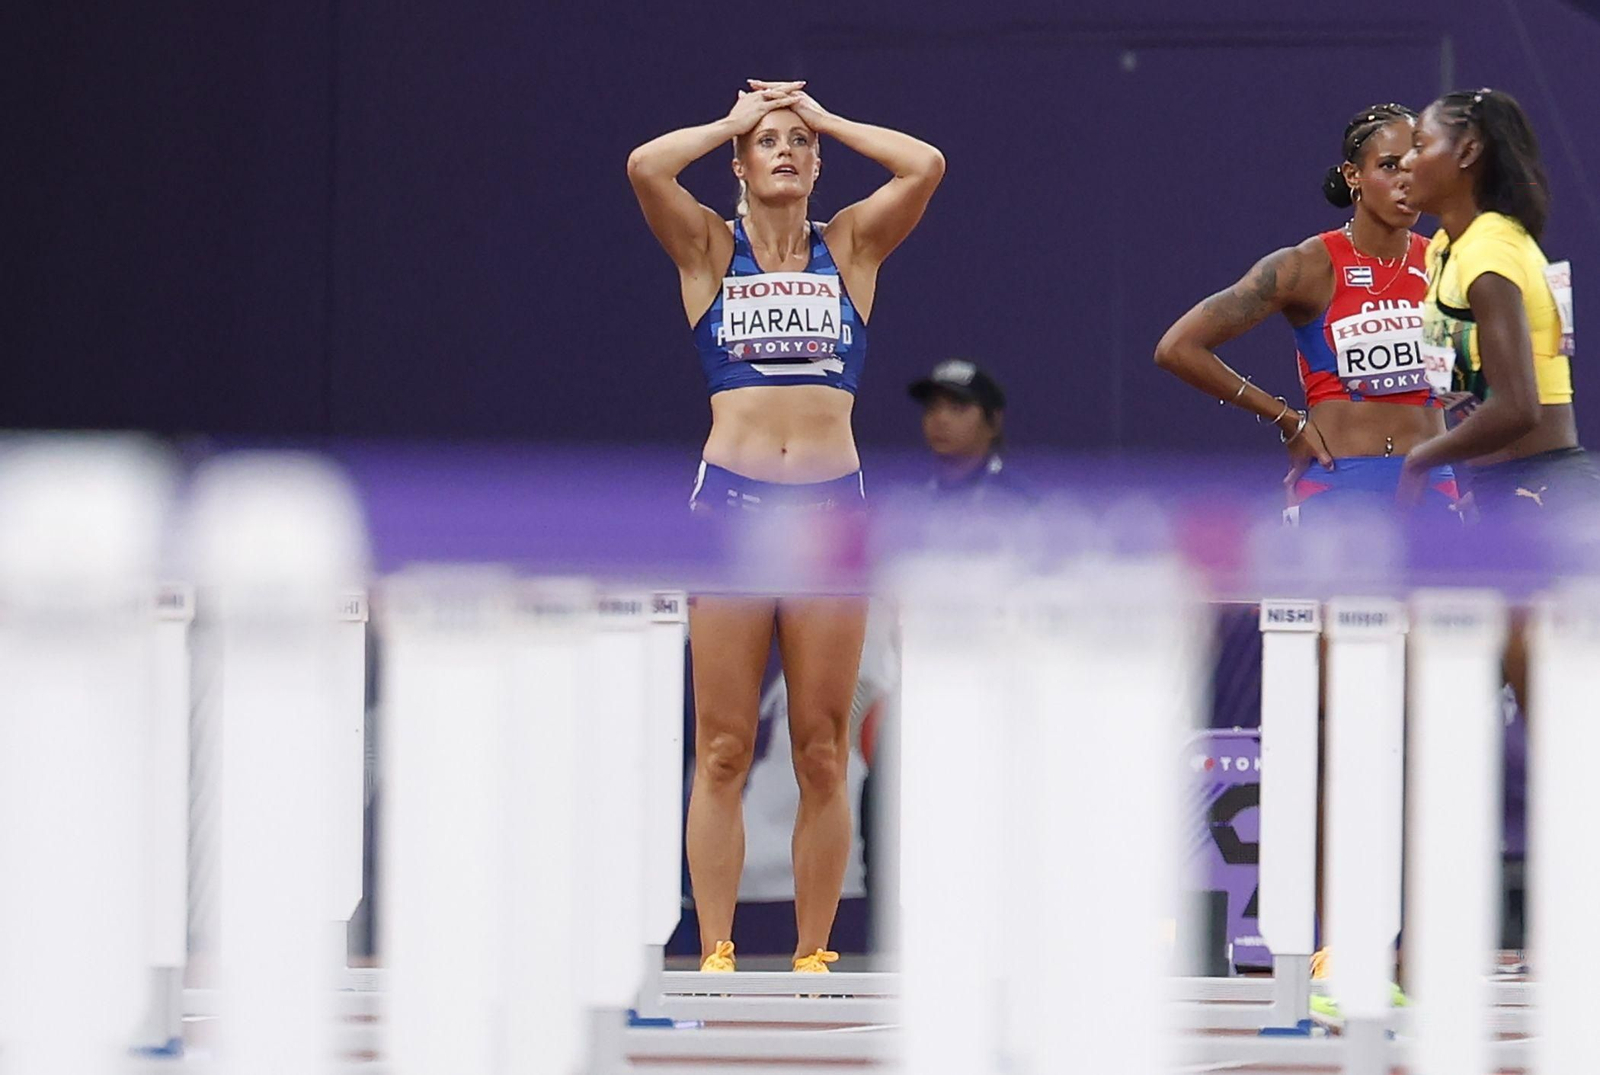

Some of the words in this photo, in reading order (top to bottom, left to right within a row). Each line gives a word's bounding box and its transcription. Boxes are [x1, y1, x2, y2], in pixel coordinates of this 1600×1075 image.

[726, 281, 836, 300] HONDA
[731, 308, 835, 336] HARALA
[1336, 316, 1423, 340] HOND
[1346, 341, 1424, 373] ROBL
[1371, 373, 1421, 390] TOKY
[1267, 609, 1314, 624] NISHI
